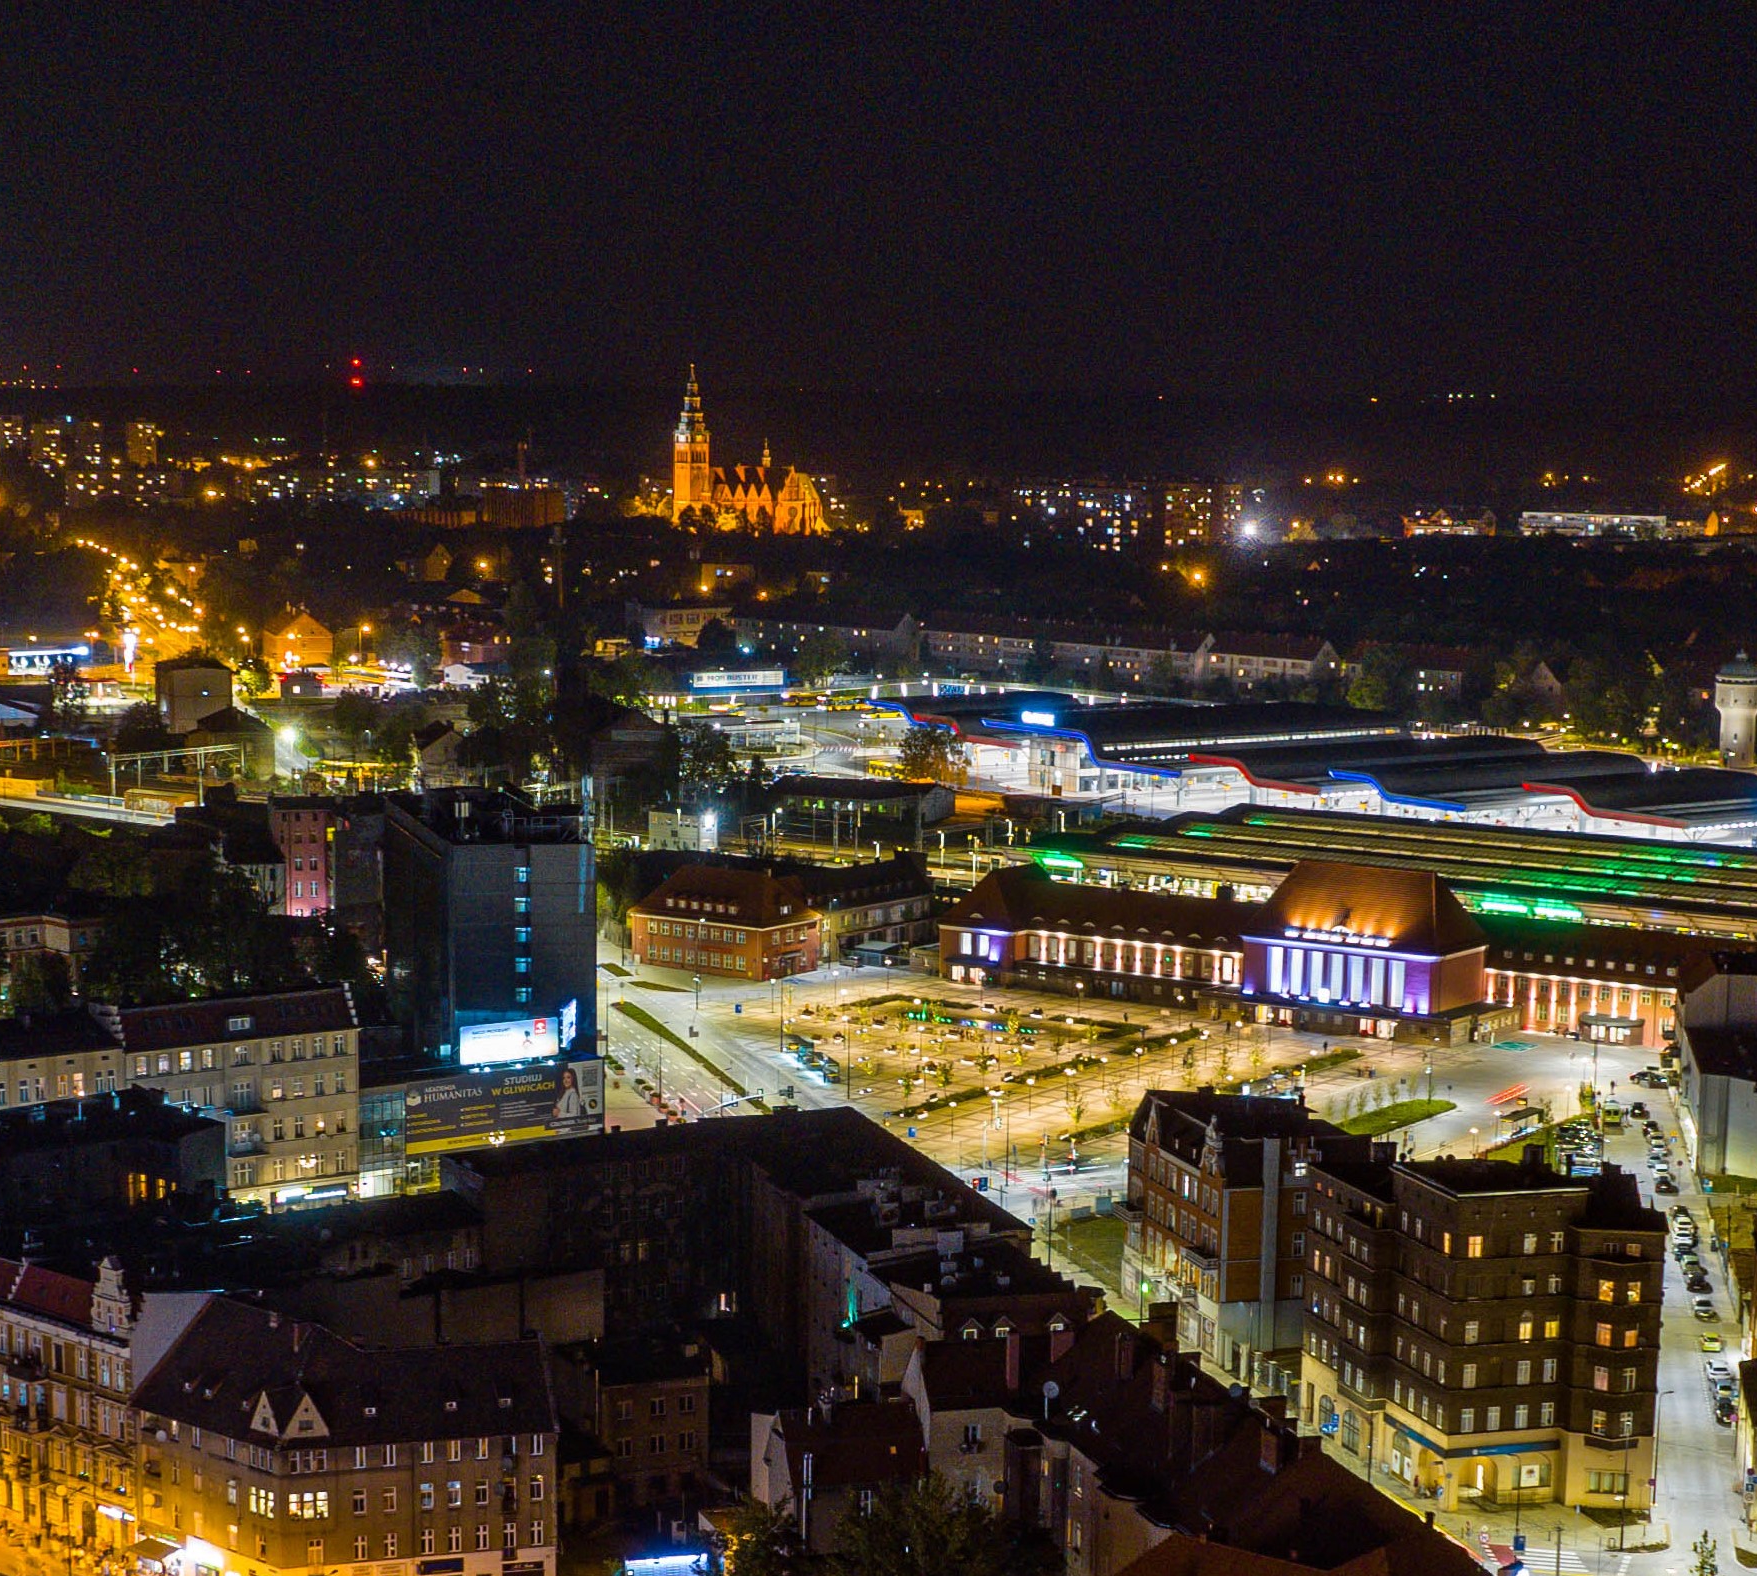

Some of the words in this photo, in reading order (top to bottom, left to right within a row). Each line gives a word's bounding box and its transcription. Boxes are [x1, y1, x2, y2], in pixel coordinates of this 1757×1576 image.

[504, 1072, 542, 1085] STUDIUJ
[424, 1088, 483, 1103] HUMANITAS
[491, 1087, 501, 1096] W
[503, 1081, 555, 1095] GLIWICACH
